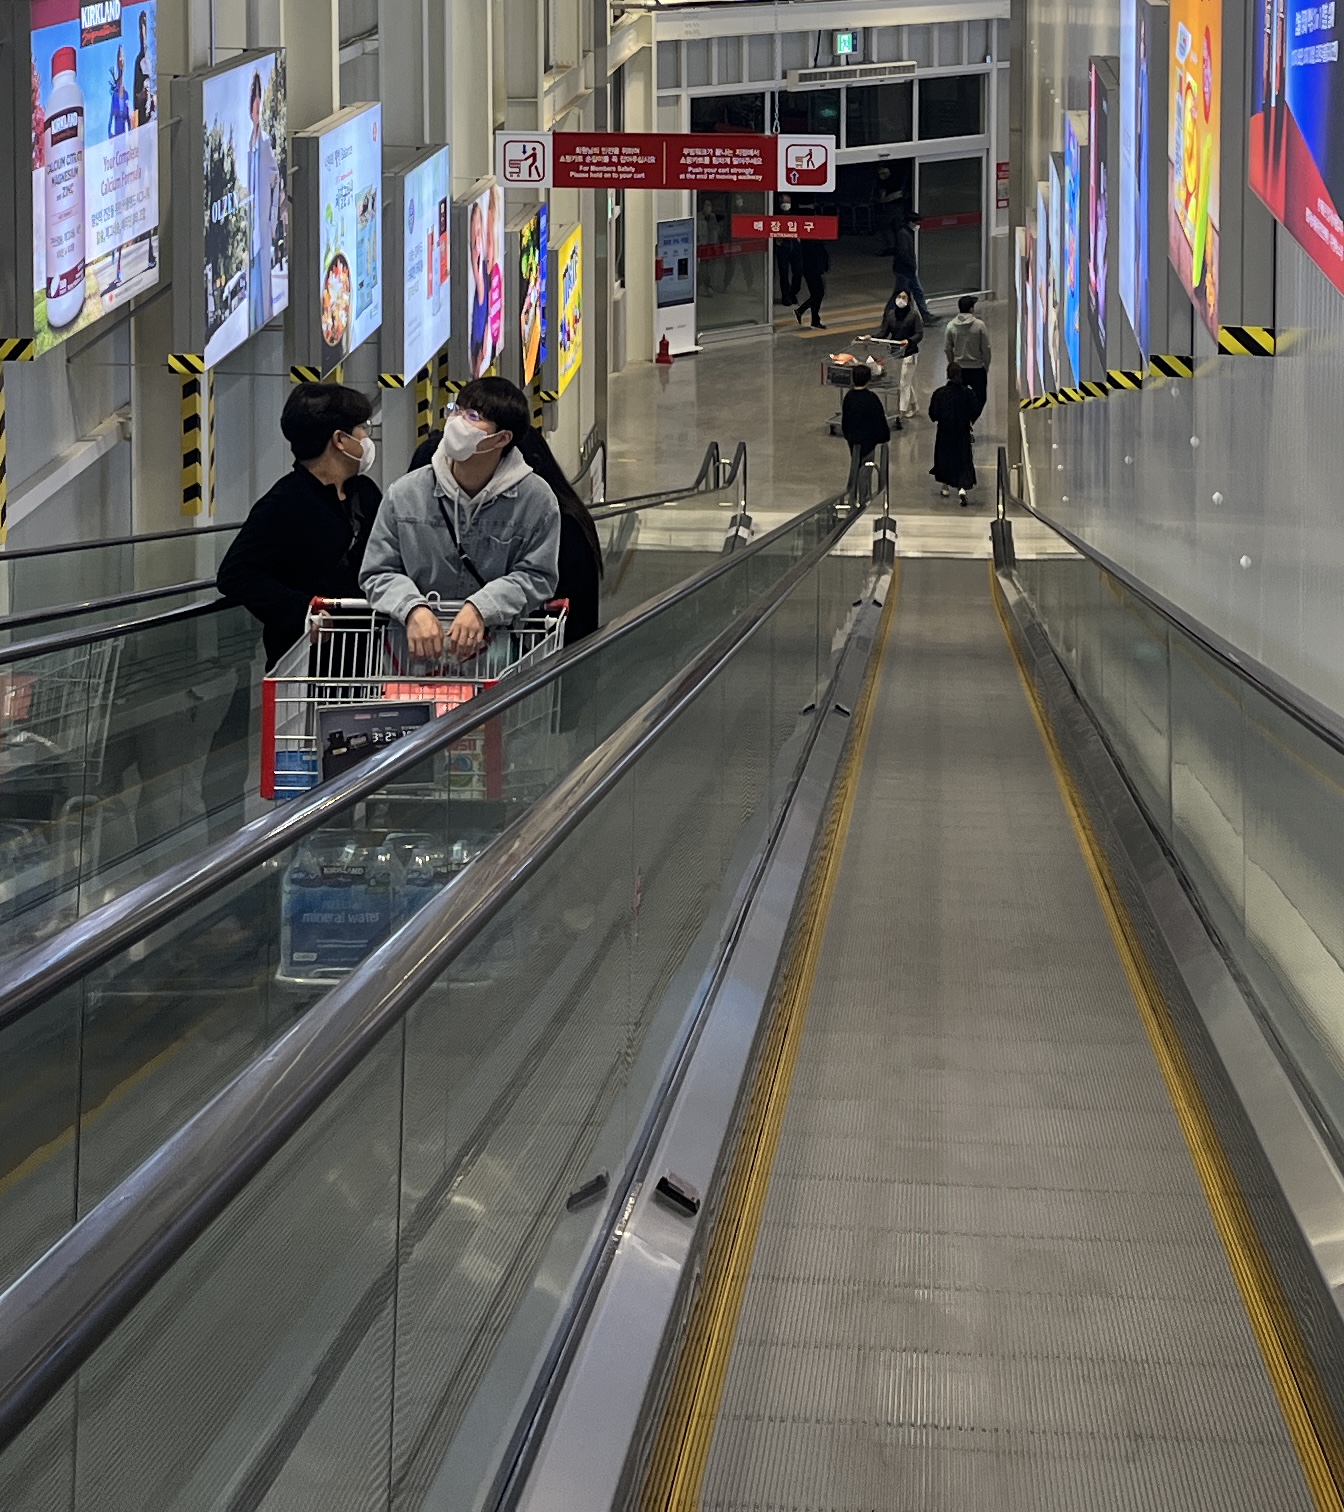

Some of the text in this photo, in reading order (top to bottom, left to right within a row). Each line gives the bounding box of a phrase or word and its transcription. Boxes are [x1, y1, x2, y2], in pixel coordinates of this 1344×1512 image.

[100, 166, 142, 196] Calcium Formula
[302, 911, 380, 924] mineral water
